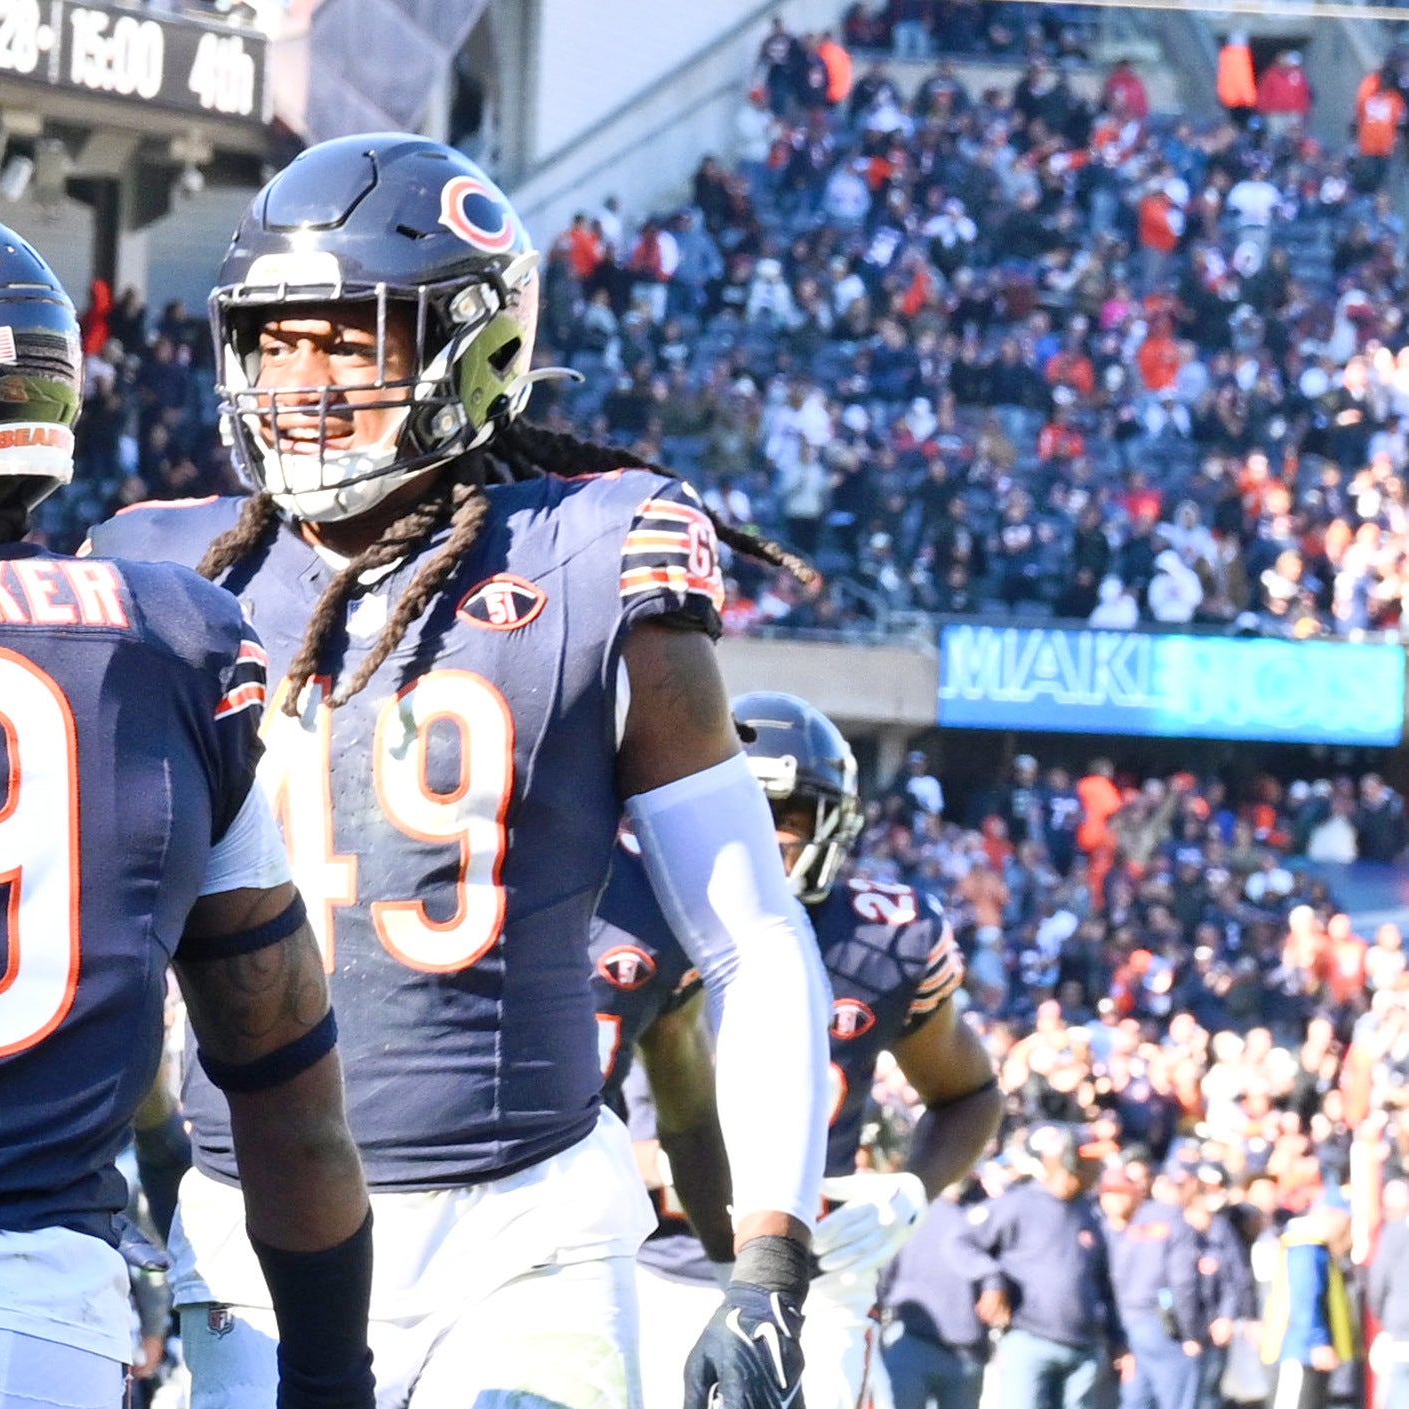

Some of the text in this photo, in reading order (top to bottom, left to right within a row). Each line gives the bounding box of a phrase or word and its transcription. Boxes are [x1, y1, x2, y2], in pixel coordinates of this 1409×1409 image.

[70, 7, 164, 99] 15:00
[189, 32, 255, 115] 4th
[485, 591, 519, 625] 51
[257, 668, 517, 975] 49
